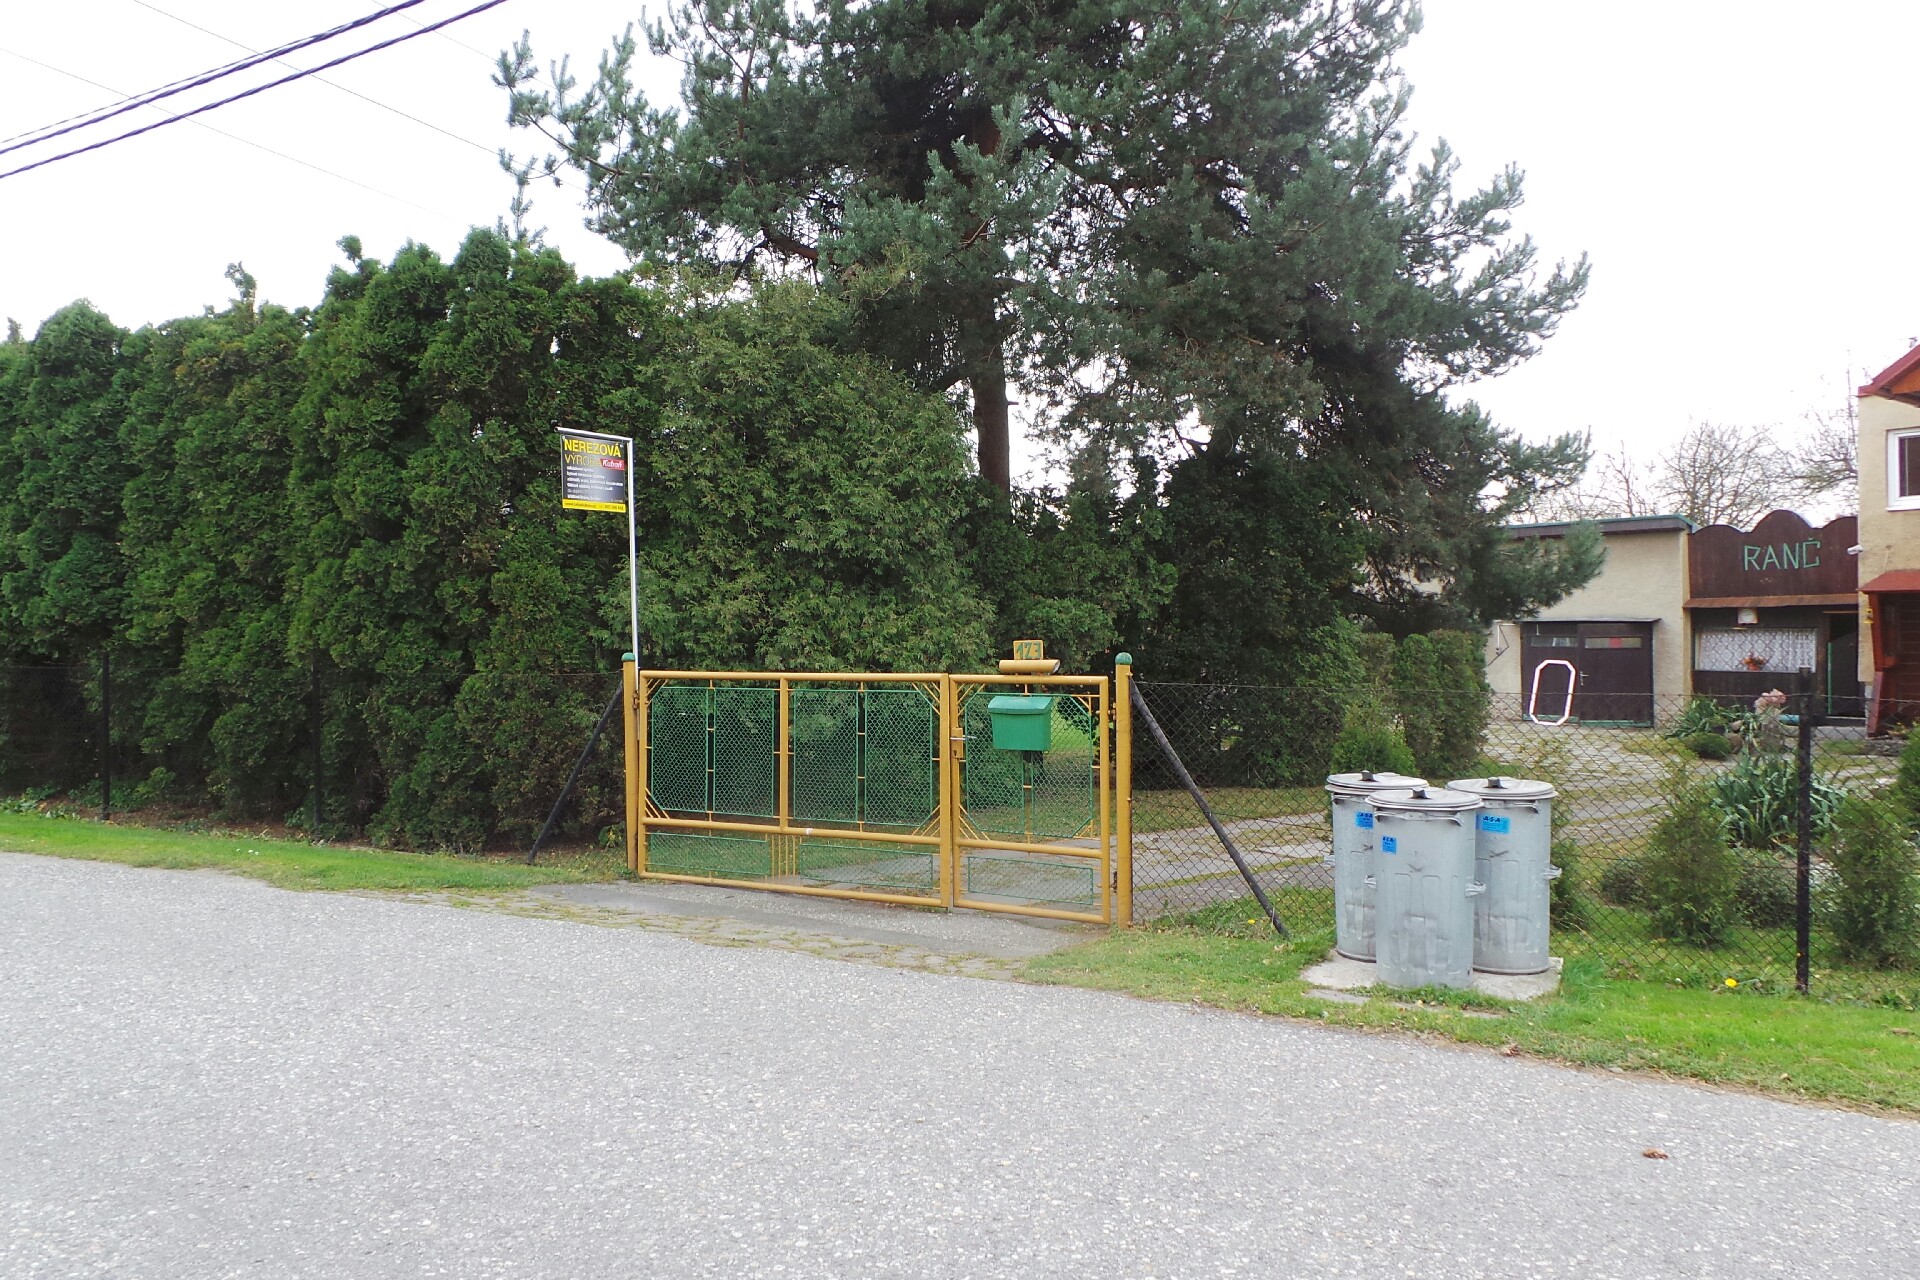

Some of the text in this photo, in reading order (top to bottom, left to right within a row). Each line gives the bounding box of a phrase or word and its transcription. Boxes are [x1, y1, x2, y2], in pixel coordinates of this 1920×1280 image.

[564, 438, 621, 458] NEREZOVÁ
[564, 452, 602, 467] VÝROBA
[1743, 537, 1821, 571] RANČ
